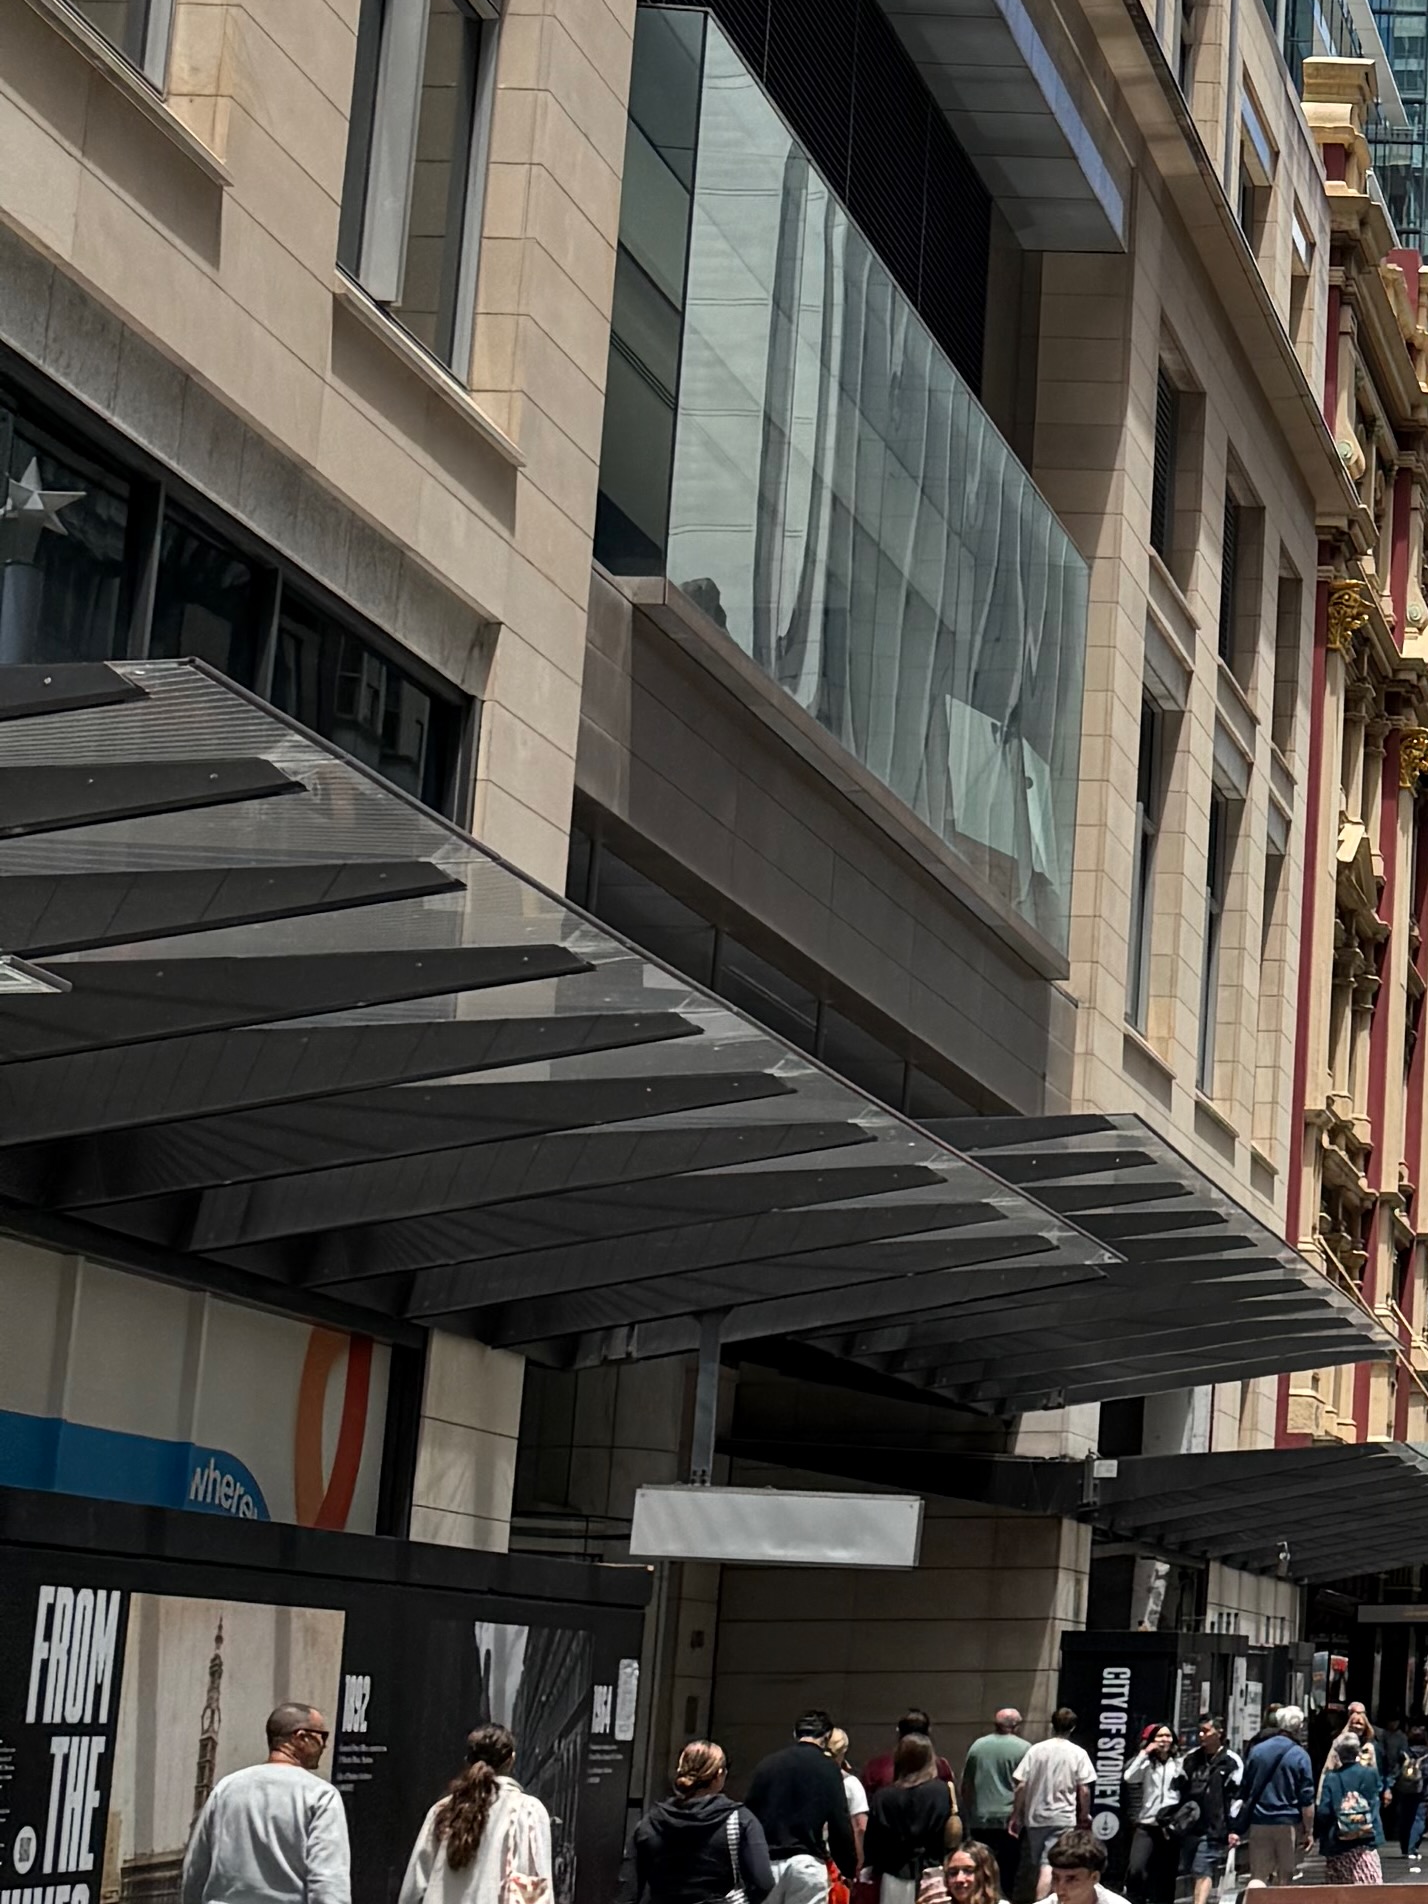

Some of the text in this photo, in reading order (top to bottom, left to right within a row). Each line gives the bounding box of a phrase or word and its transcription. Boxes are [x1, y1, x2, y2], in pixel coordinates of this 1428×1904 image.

[26, 1585, 121, 1724] FROM
[42, 1736, 106, 1874] THE
[1094, 1667, 1131, 1808] CITY OF SYDNEY
